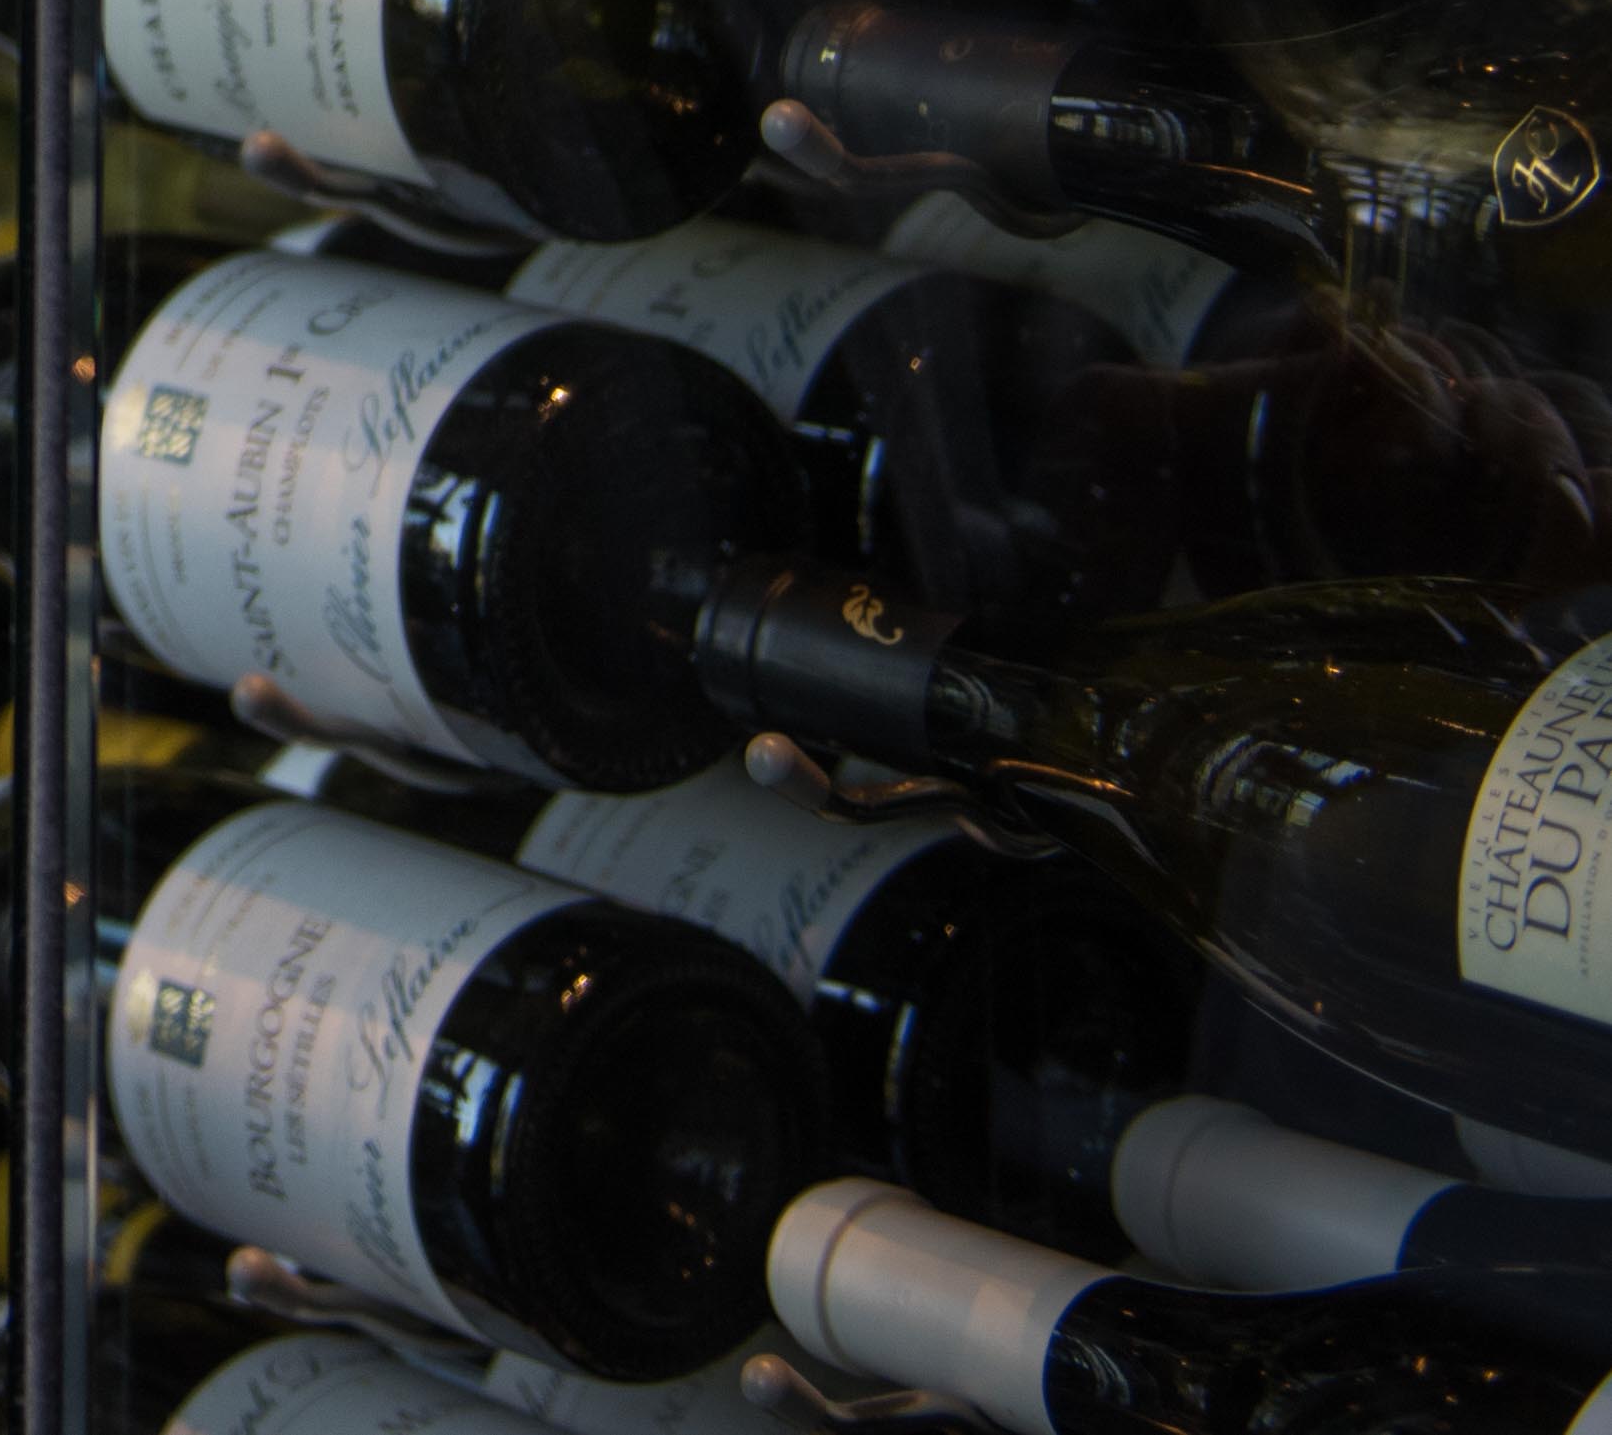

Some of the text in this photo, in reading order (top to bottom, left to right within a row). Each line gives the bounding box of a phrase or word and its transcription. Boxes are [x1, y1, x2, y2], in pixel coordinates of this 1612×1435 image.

[342, 321, 487, 498] Leflaive
[224, 398, 297, 680] SAINT-AUBIN
[1467, 765, 1509, 940] VIEILLES
[1483, 649, 1612, 953] CHÂTEAUNEU
[1522, 815, 1583, 940] DU
[1577, 850, 1602, 978] APPELLATION
[243, 915, 332, 1201] BOURGOGNE
